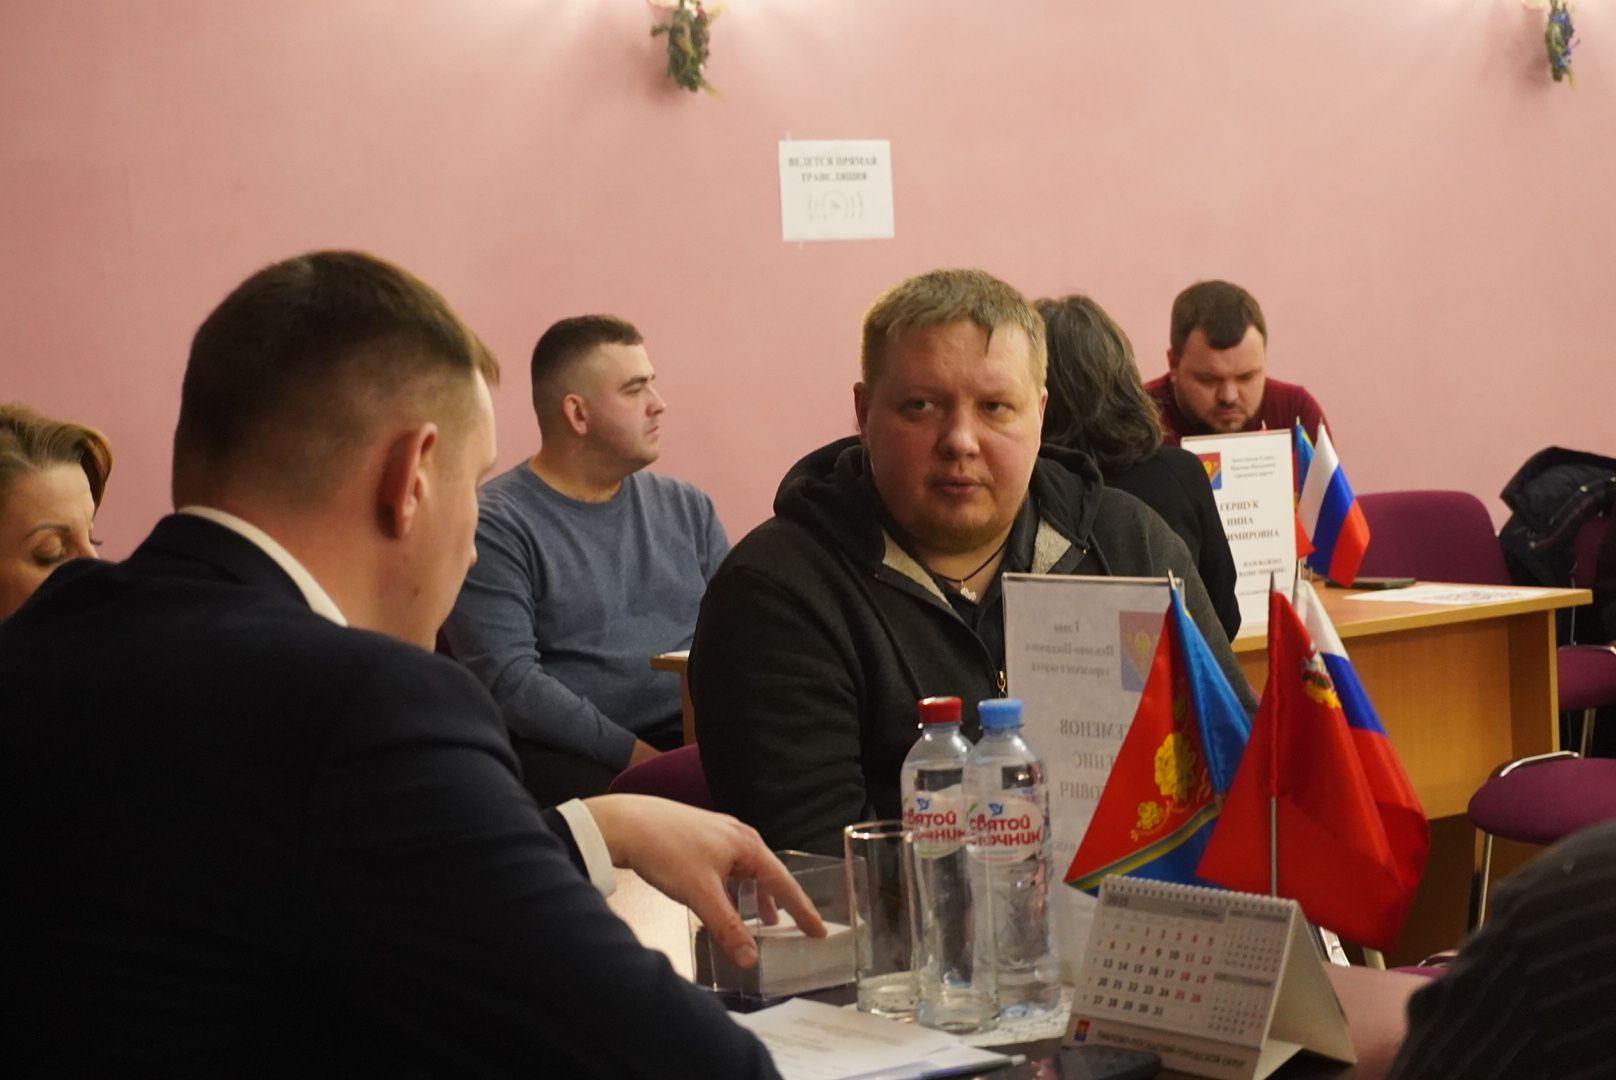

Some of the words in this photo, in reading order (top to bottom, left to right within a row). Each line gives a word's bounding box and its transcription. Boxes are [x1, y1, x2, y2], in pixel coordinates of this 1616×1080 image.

[835, 156, 877, 166] ПРЯМАЯ
[1220, 501, 1259, 512] ГЕРЩУК
[1227, 516, 1253, 527] НИНА
[1226, 529, 1280, 542] ИМИРОВНА
